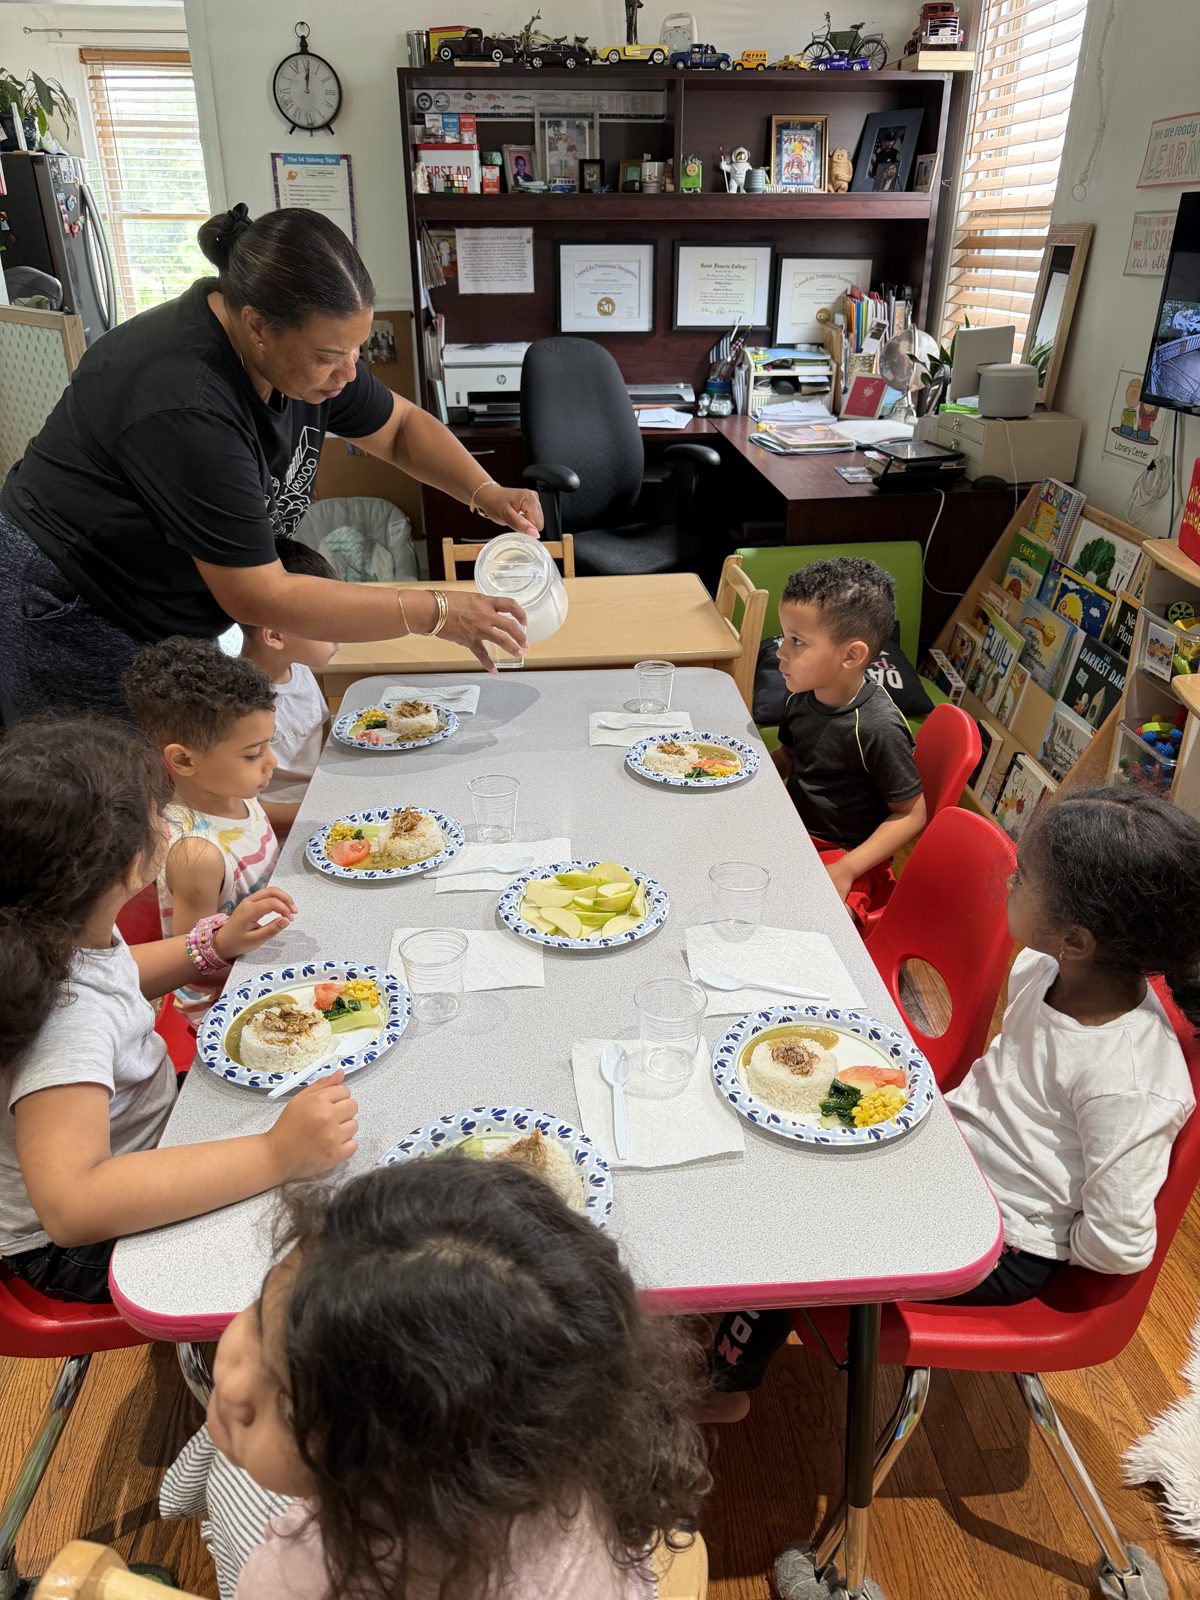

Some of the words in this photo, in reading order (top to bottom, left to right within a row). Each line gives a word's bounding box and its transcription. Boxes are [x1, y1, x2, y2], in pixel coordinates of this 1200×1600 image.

[1163, 127, 1175, 138] are
[1174, 120, 1198, 138] ready
[1144, 139, 1200, 180] LEARN
[425, 165, 453, 180] FIRST
[456, 165, 472, 180] AID
[1133, 239, 1143, 250] we
[1114, 440, 1132, 456] Library
[1131, 446, 1149, 460] Center
[1020, 543, 1037, 561] EARTH
[982, 623, 1014, 680] Bully
[1079, 647, 1111, 677] DARKEST
[1108, 669, 1126, 691] DAR
